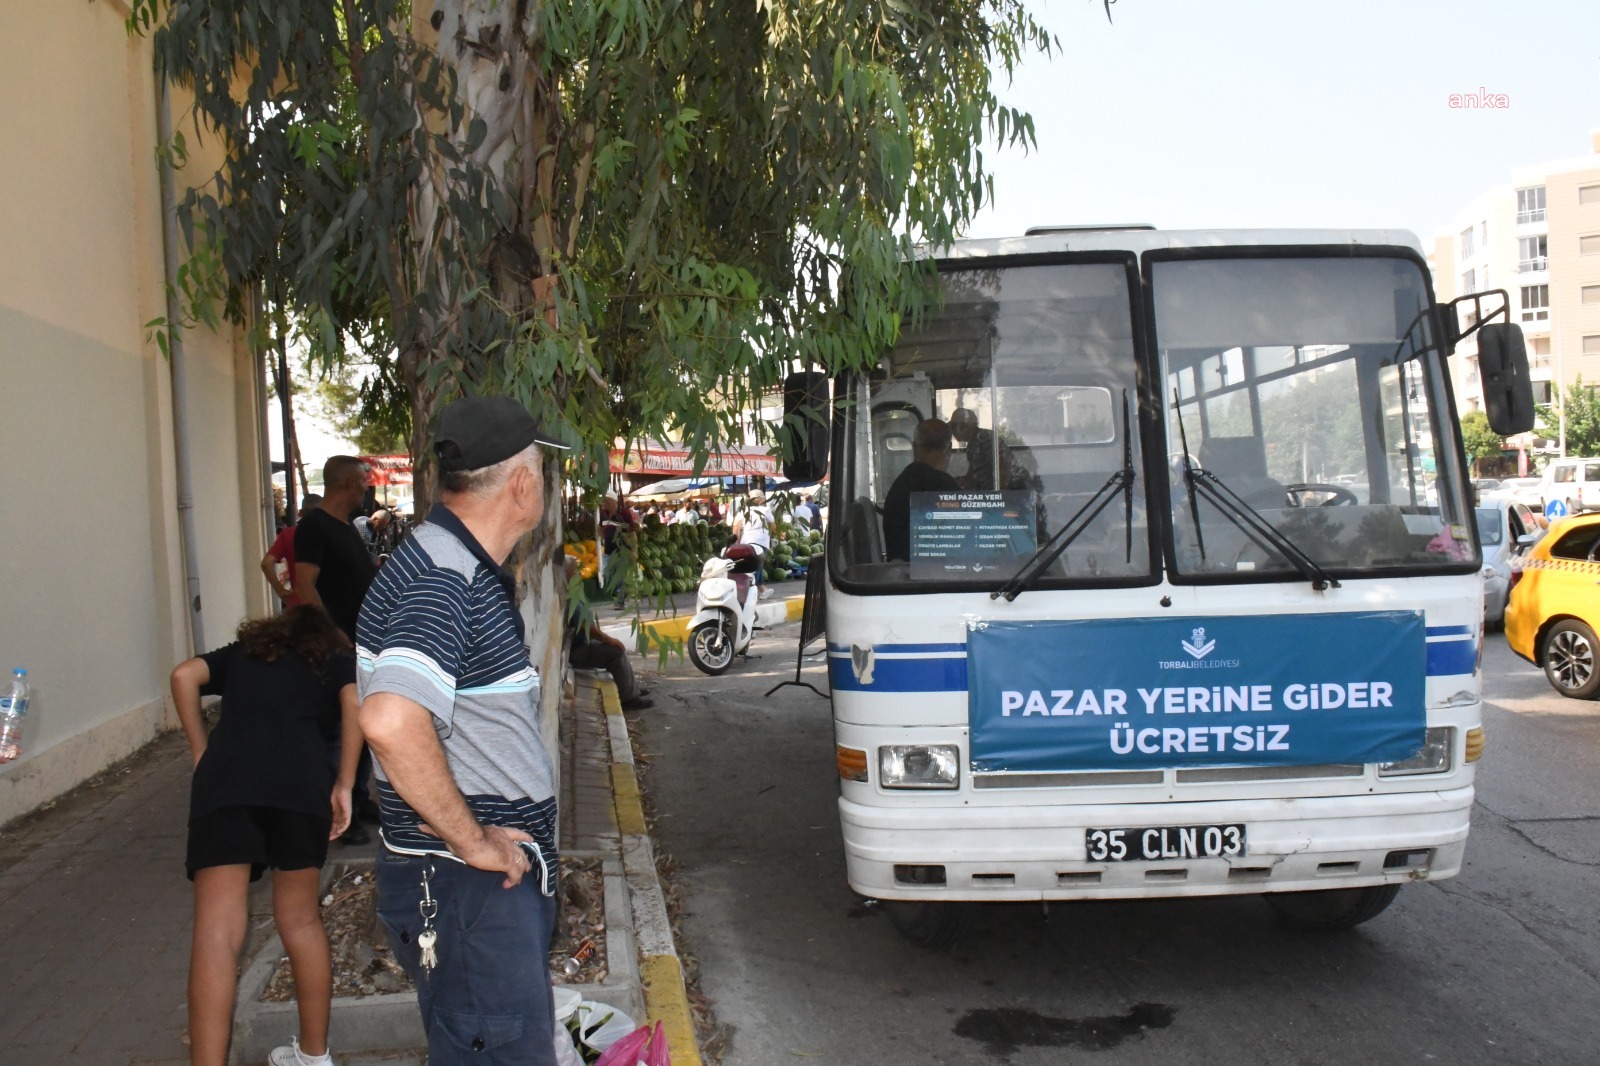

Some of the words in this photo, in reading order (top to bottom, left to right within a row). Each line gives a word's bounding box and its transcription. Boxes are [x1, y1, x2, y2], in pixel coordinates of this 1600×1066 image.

[1001, 689, 1128, 717] PAZAR
[1090, 830, 1127, 861] 35
[1142, 828, 1198, 860] CLN
